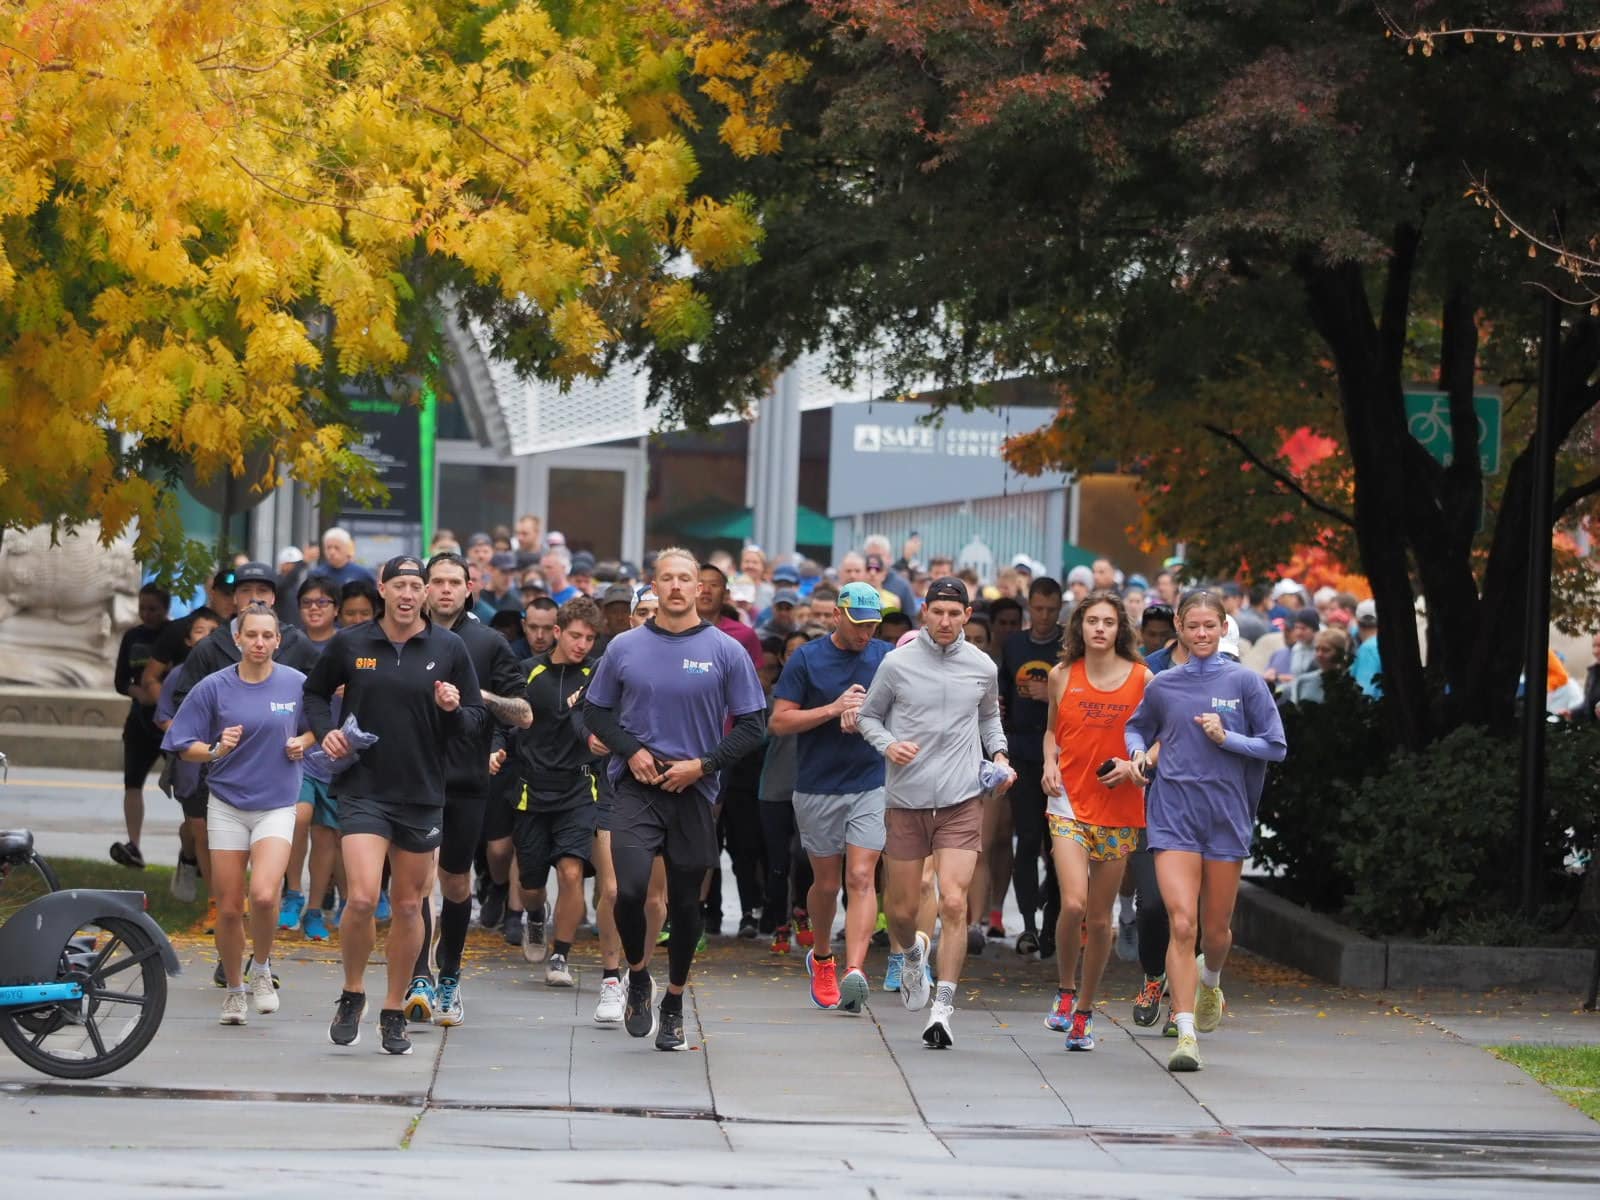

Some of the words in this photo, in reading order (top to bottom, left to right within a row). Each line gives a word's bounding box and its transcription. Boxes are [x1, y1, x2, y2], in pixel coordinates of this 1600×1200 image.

[881, 426, 933, 446] SAFE
[946, 429, 1005, 442] CONVE
[946, 443, 1000, 457] CENTE
[1079, 701, 1105, 710] FLEET
[1107, 703, 1130, 711] FEET
